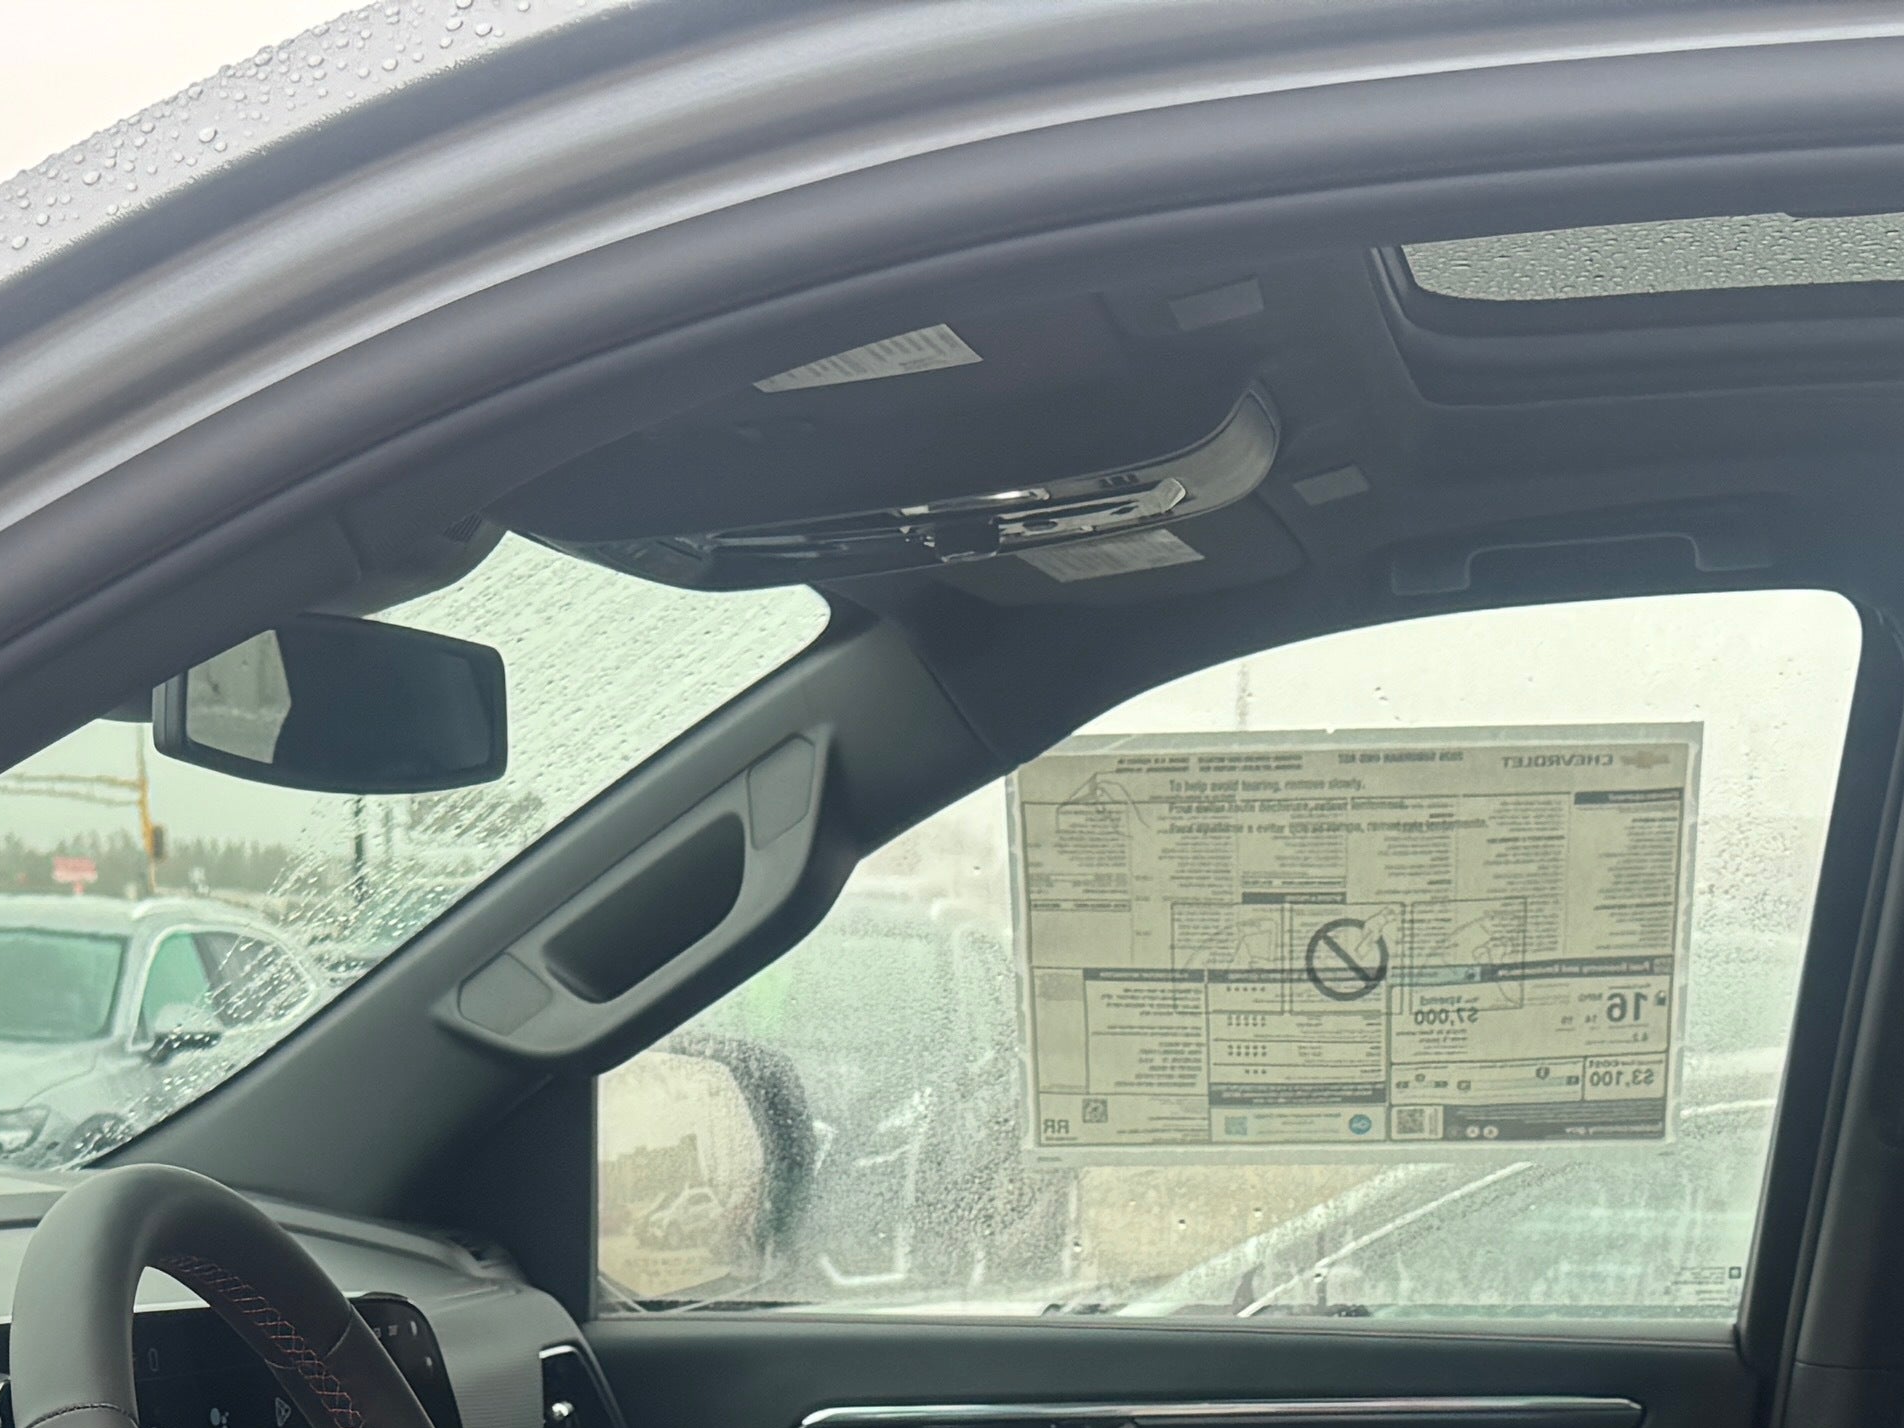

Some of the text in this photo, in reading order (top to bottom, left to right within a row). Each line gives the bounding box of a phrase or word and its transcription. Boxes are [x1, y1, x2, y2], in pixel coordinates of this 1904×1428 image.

[1169, 780, 1183, 793] To
[1185, 780, 1208, 794] help
[1210, 779, 1239, 792] avoid
[1284, 779, 1326, 791] remove
